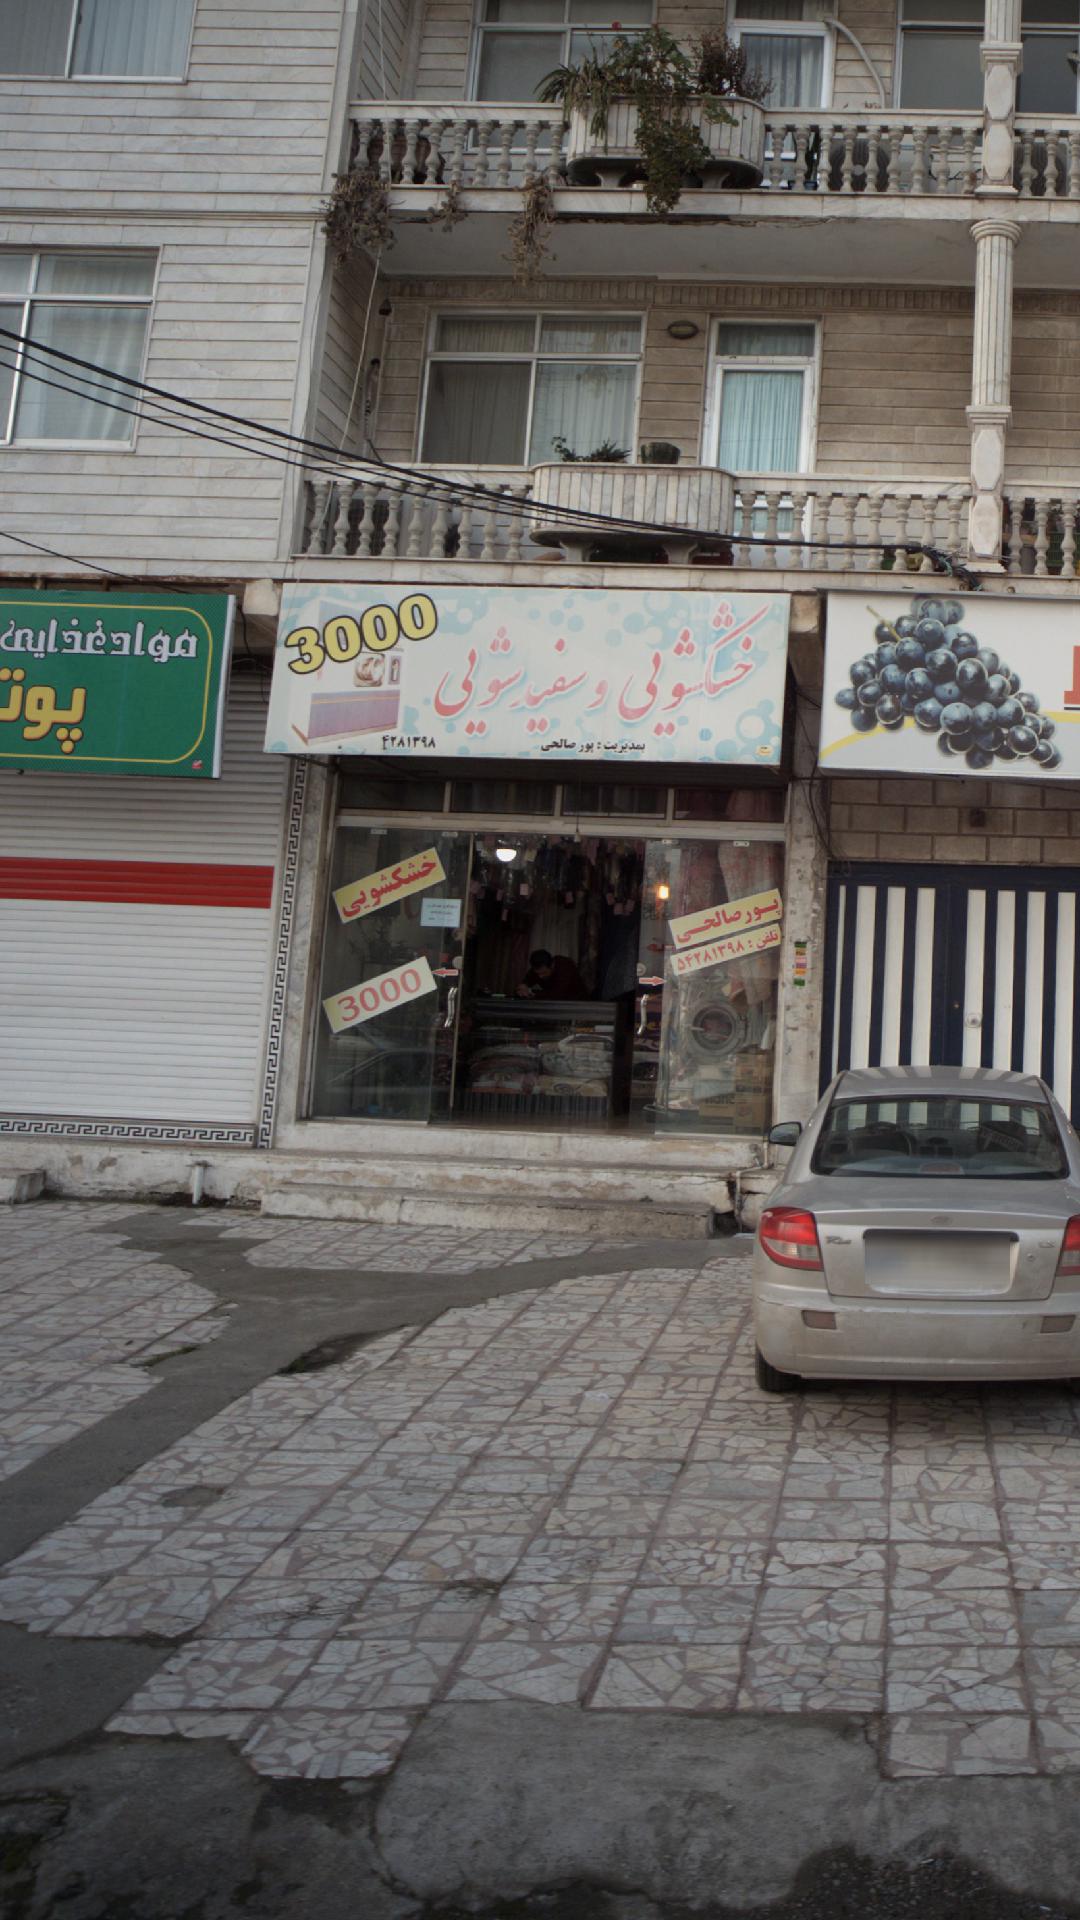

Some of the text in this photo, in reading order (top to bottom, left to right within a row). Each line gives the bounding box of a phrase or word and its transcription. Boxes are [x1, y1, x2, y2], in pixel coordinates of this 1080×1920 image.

[0, 618, 199, 663] مواد غذایی
[284, 592, 438, 674] 3000
[0, 667, 87, 754] پوت
[587, 680, 609, 709] و
[541, 738, 577, 752] صالحی
[676, 908, 742, 943] صالحی
[337, 968, 422, 1022] 3000
